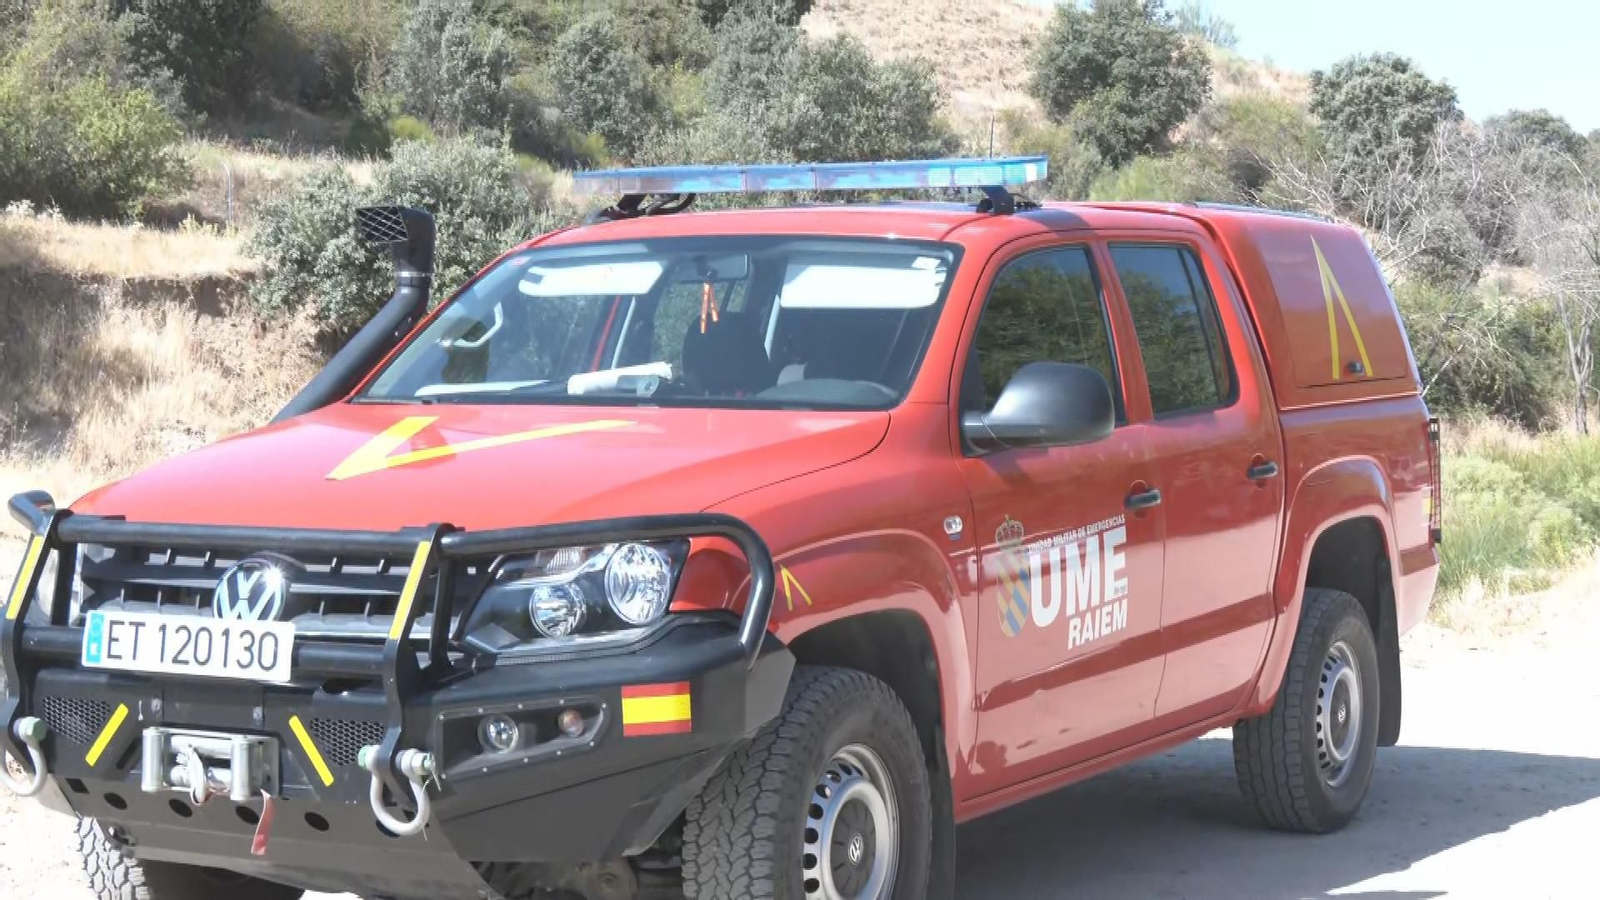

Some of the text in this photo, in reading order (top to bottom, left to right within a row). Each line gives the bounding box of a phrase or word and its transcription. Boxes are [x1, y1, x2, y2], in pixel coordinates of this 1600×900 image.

[1053, 529, 1077, 546] MILITAR
[1078, 527, 1086, 538] DE
[1087, 513, 1126, 534] EMERGENCIAS
[1029, 525, 1128, 628] UME
[106, 620, 279, 671] ET 120130
[1067, 598, 1129, 651] RAIEM
